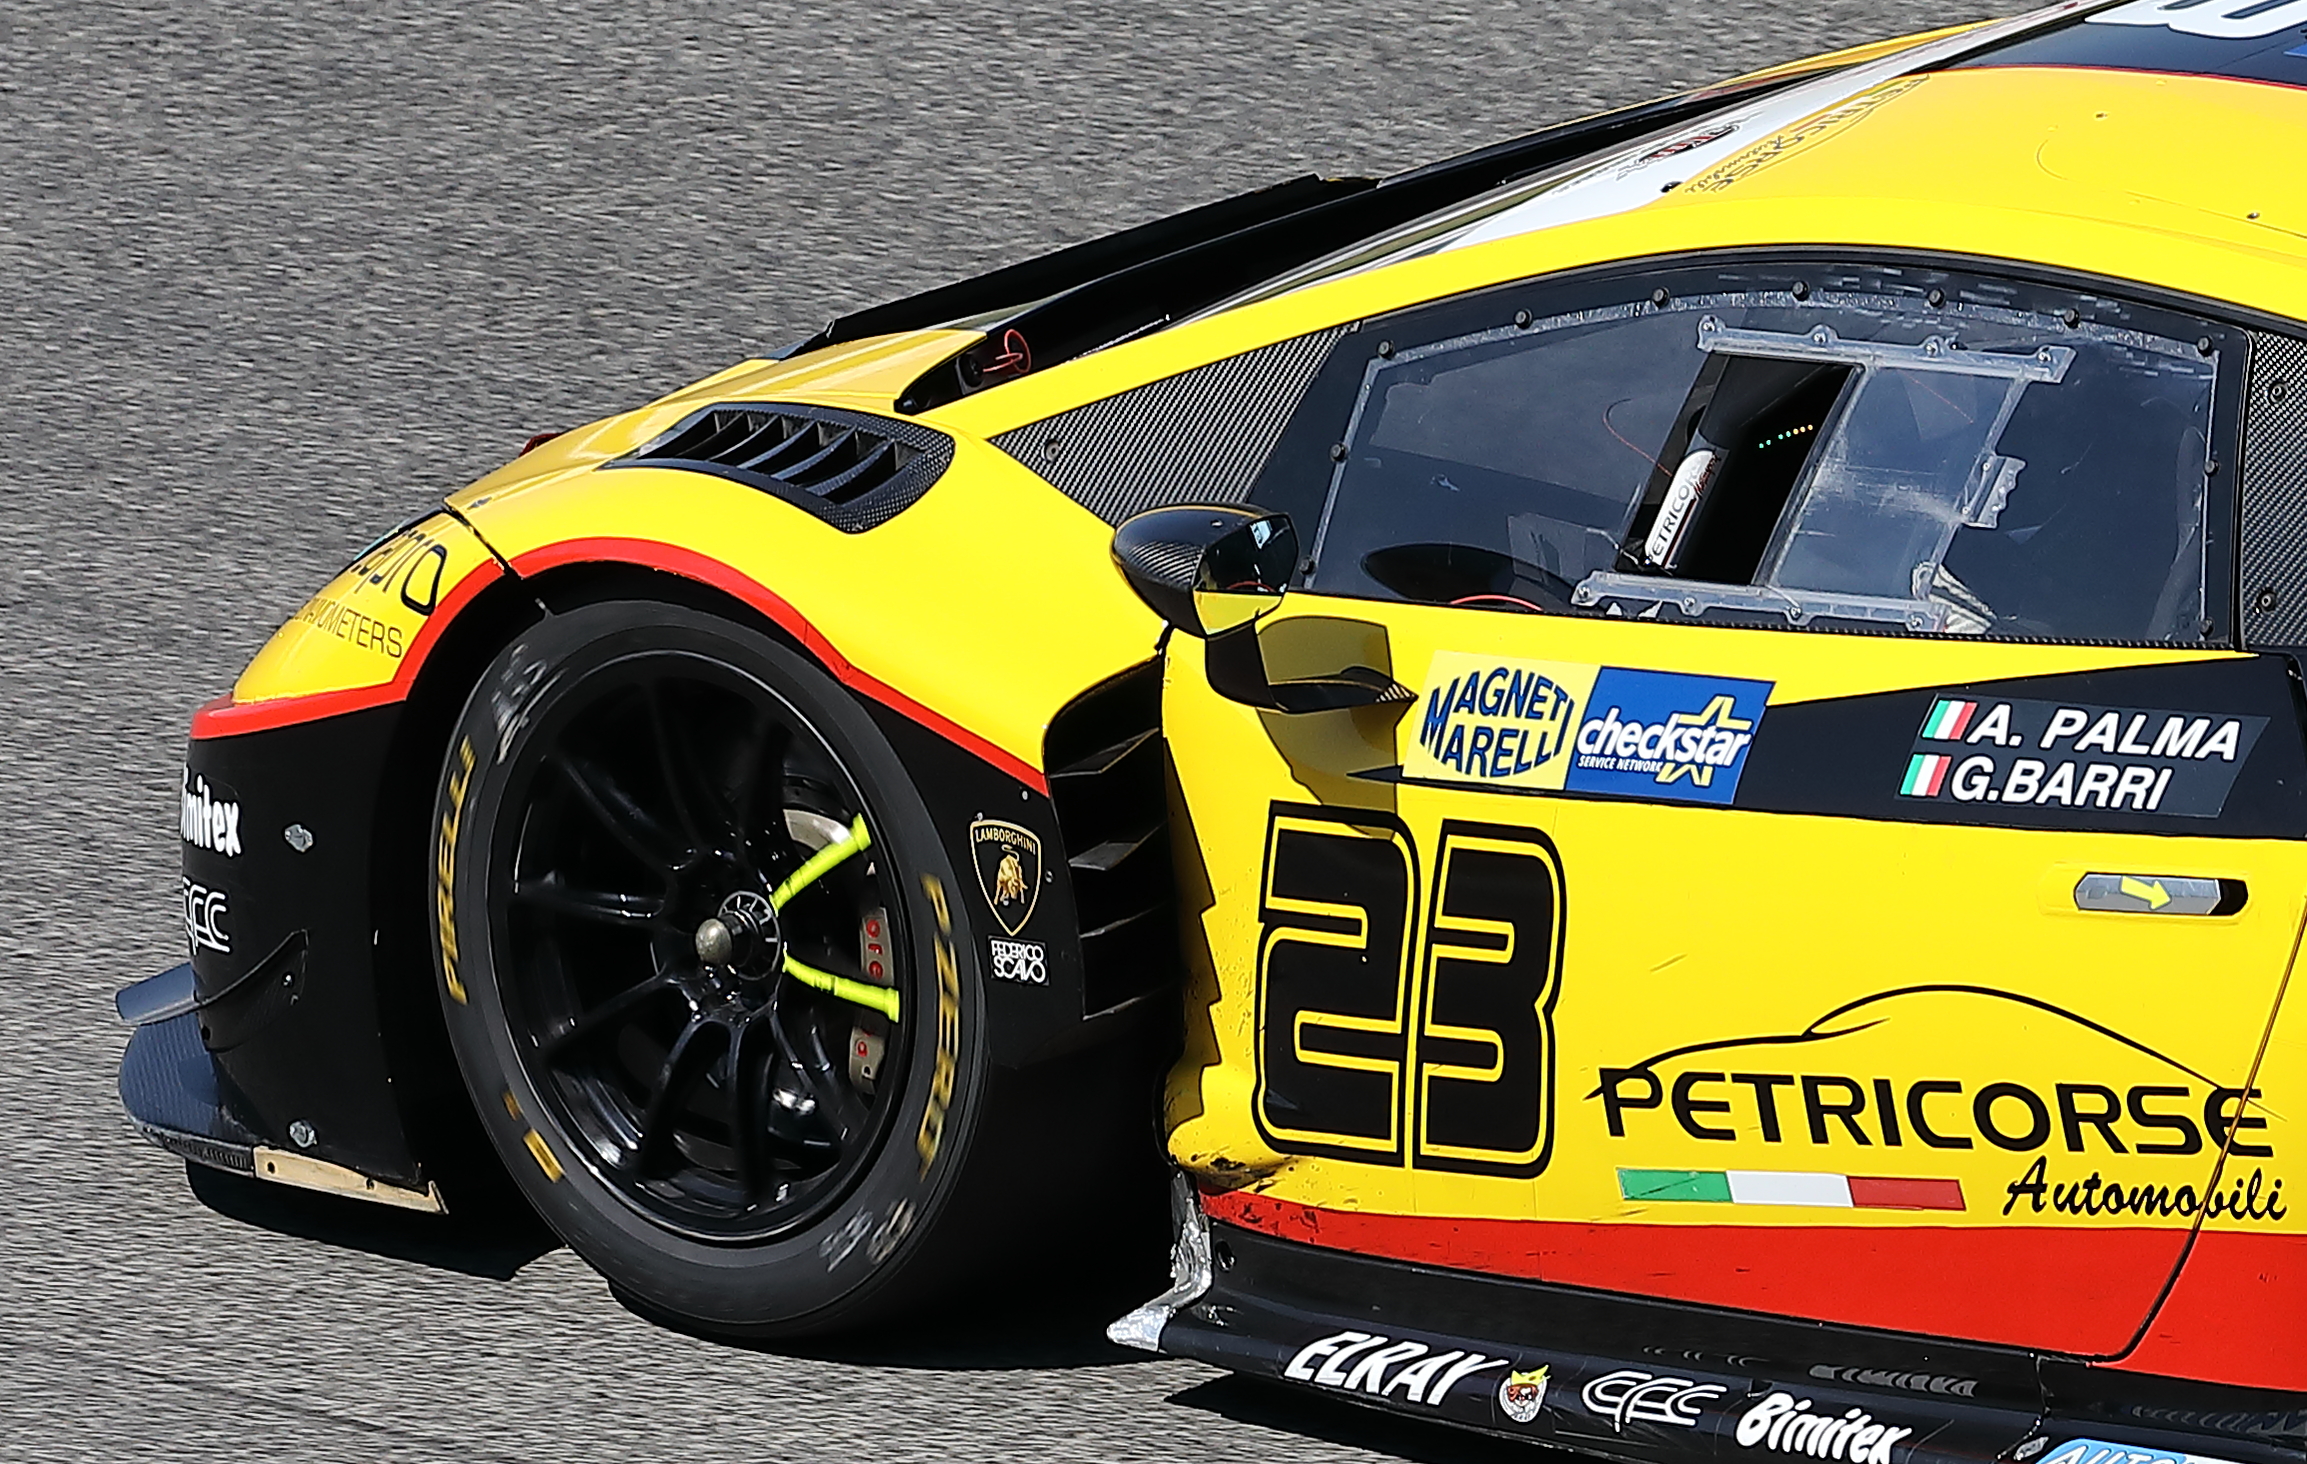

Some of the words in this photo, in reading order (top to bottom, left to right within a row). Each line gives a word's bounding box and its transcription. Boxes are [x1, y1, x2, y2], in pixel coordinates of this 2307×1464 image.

[1420, 666, 1575, 735] MAGNETI
[1420, 708, 1575, 778] MARELLI
[1577, 707, 1751, 767] checkstar
[1966, 704, 2023, 746] A.
[2040, 709, 2240, 760] PALMA
[1578, 755, 1617, 769] SERVICE
[1616, 758, 1662, 772] NETWORK
[1951, 756, 2172, 811] G.BARRI
[438, 735, 476, 1004] PIRELLI
[975, 827, 1036, 856] LAMBORGHINI
[991, 940, 1044, 961] FEDERICO
[994, 956, 1046, 983] SCAVO
[1252, 799, 1567, 1179] 23
[1599, 1067, 2274, 1157] PETRICORSE
[2002, 1157, 2288, 1221] Automobili
[1284, 1331, 1509, 1405] ELRAY
[1736, 1392, 1912, 1464] Bimitex
